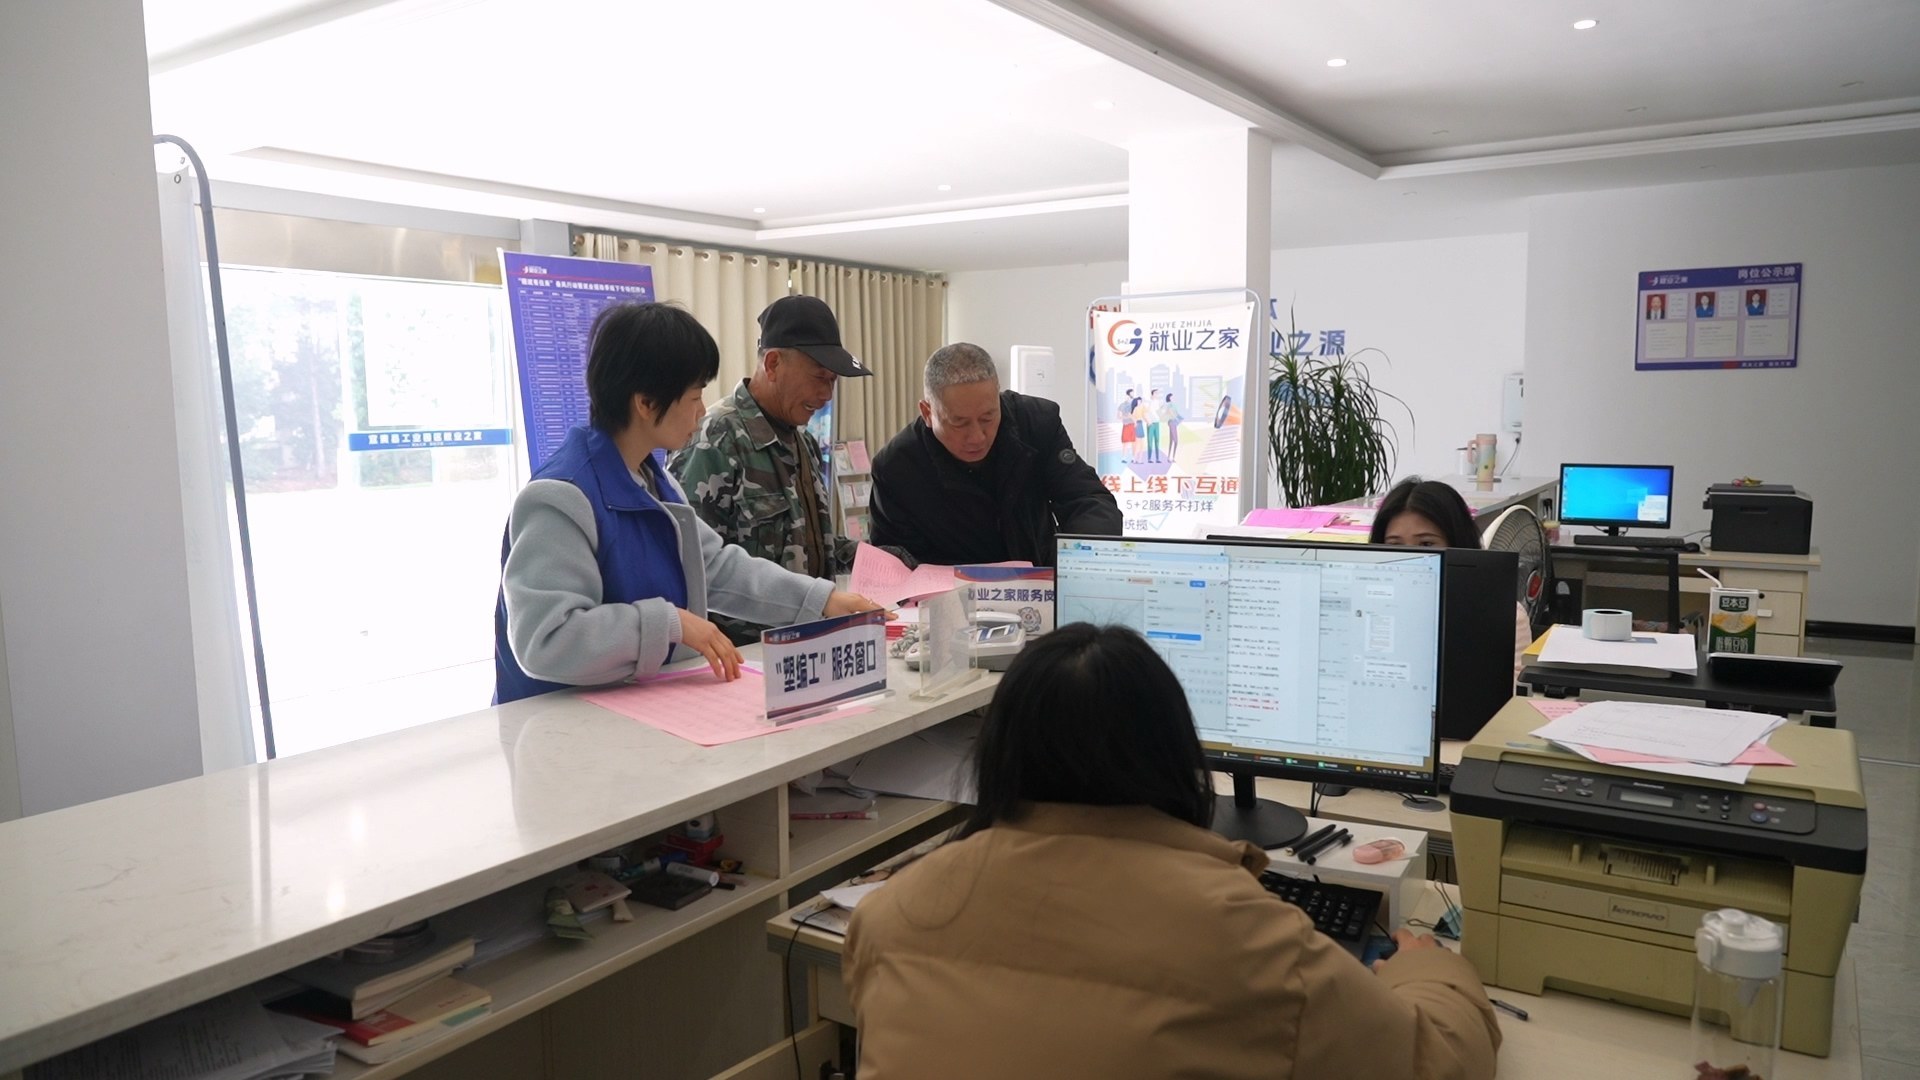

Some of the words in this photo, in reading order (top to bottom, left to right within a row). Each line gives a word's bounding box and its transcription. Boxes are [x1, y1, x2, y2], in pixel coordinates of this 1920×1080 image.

[1738, 266, 1796, 280] 岗位公示牌
[1149, 321, 1177, 330] JIUYE
[1179, 319, 1213, 329] ZHIJIA
[1149, 327, 1240, 352] 就业之家
[1101, 475, 1240, 495] 线上线下互通
[1126, 500, 1214, 513] 5+2服务不打烊
[1612, 905, 1665, 921] lenovo
